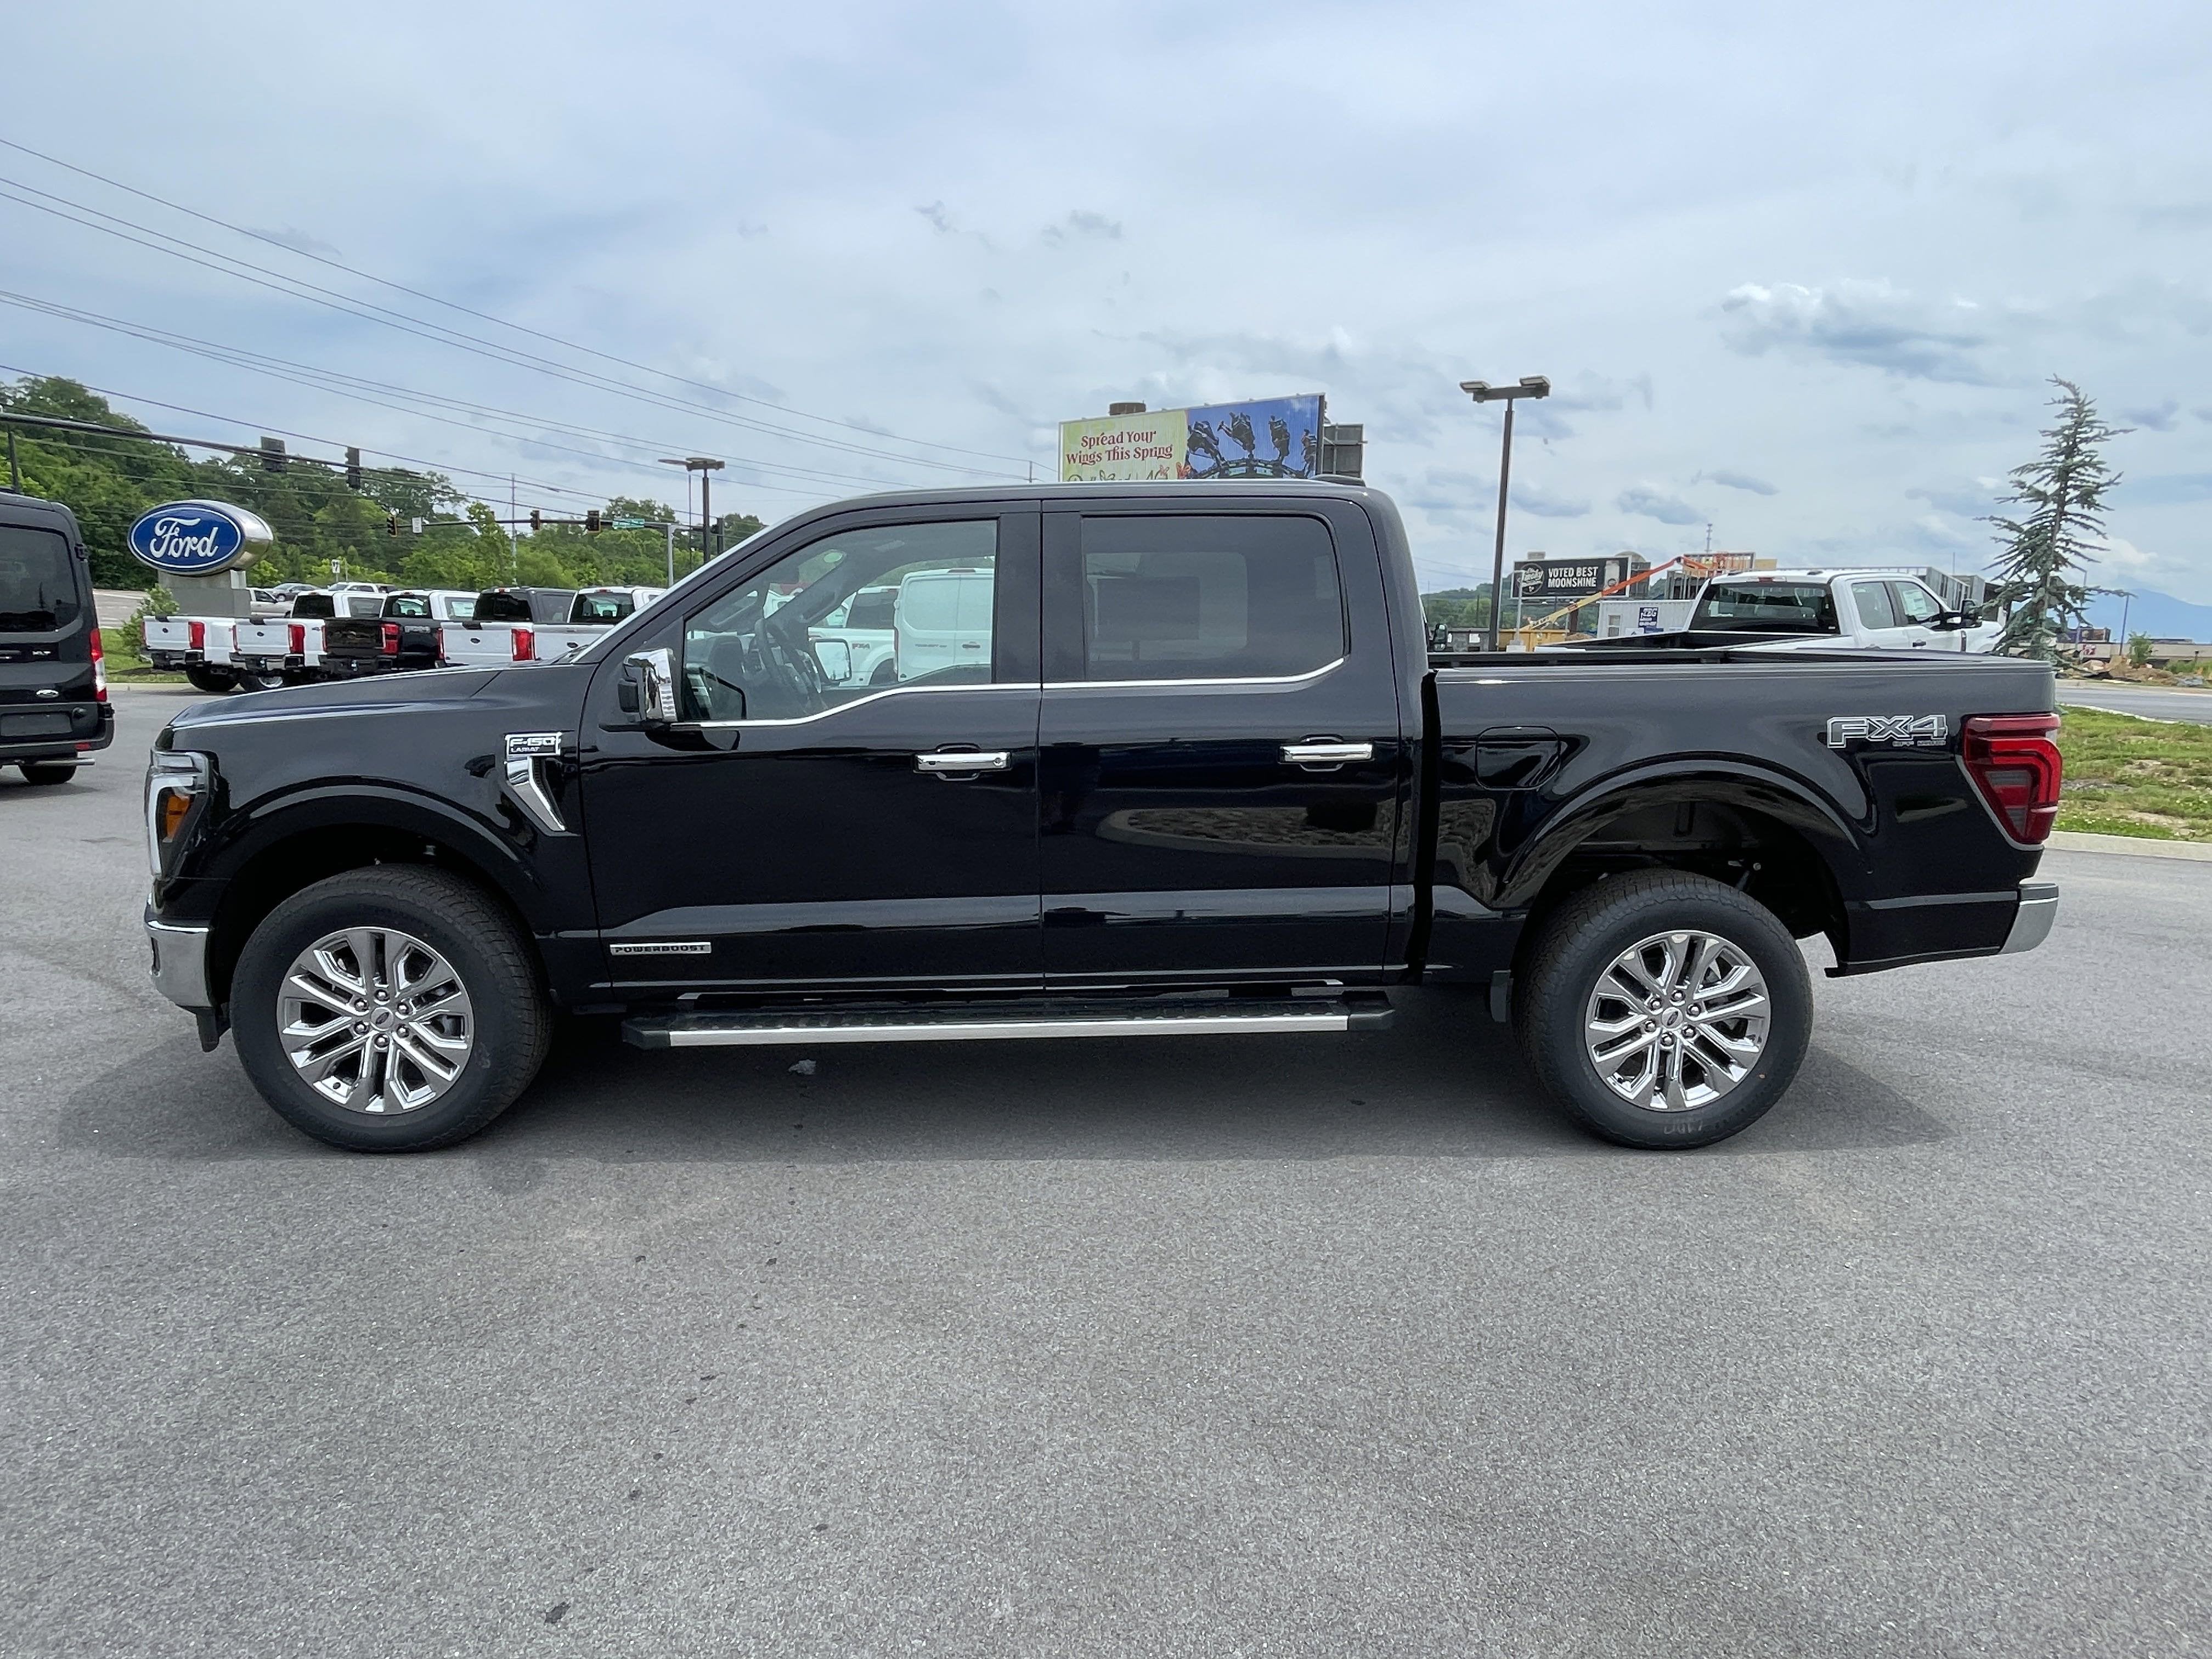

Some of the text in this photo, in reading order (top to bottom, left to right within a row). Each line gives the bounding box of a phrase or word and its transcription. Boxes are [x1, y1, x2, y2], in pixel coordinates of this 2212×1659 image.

[1081, 431, 1156, 449] Spread Your
[1066, 444, 1173, 466] Wings This Spring
[150, 517, 218, 558] Ford
[1548, 567, 1599, 578] VOTED BEST
[1547, 577, 1597, 588] MOONSHINE
[1827, 714, 1948, 748] FX4
[510, 737, 556, 747] F-150
[614, 945, 706, 953] POWERBOOST
